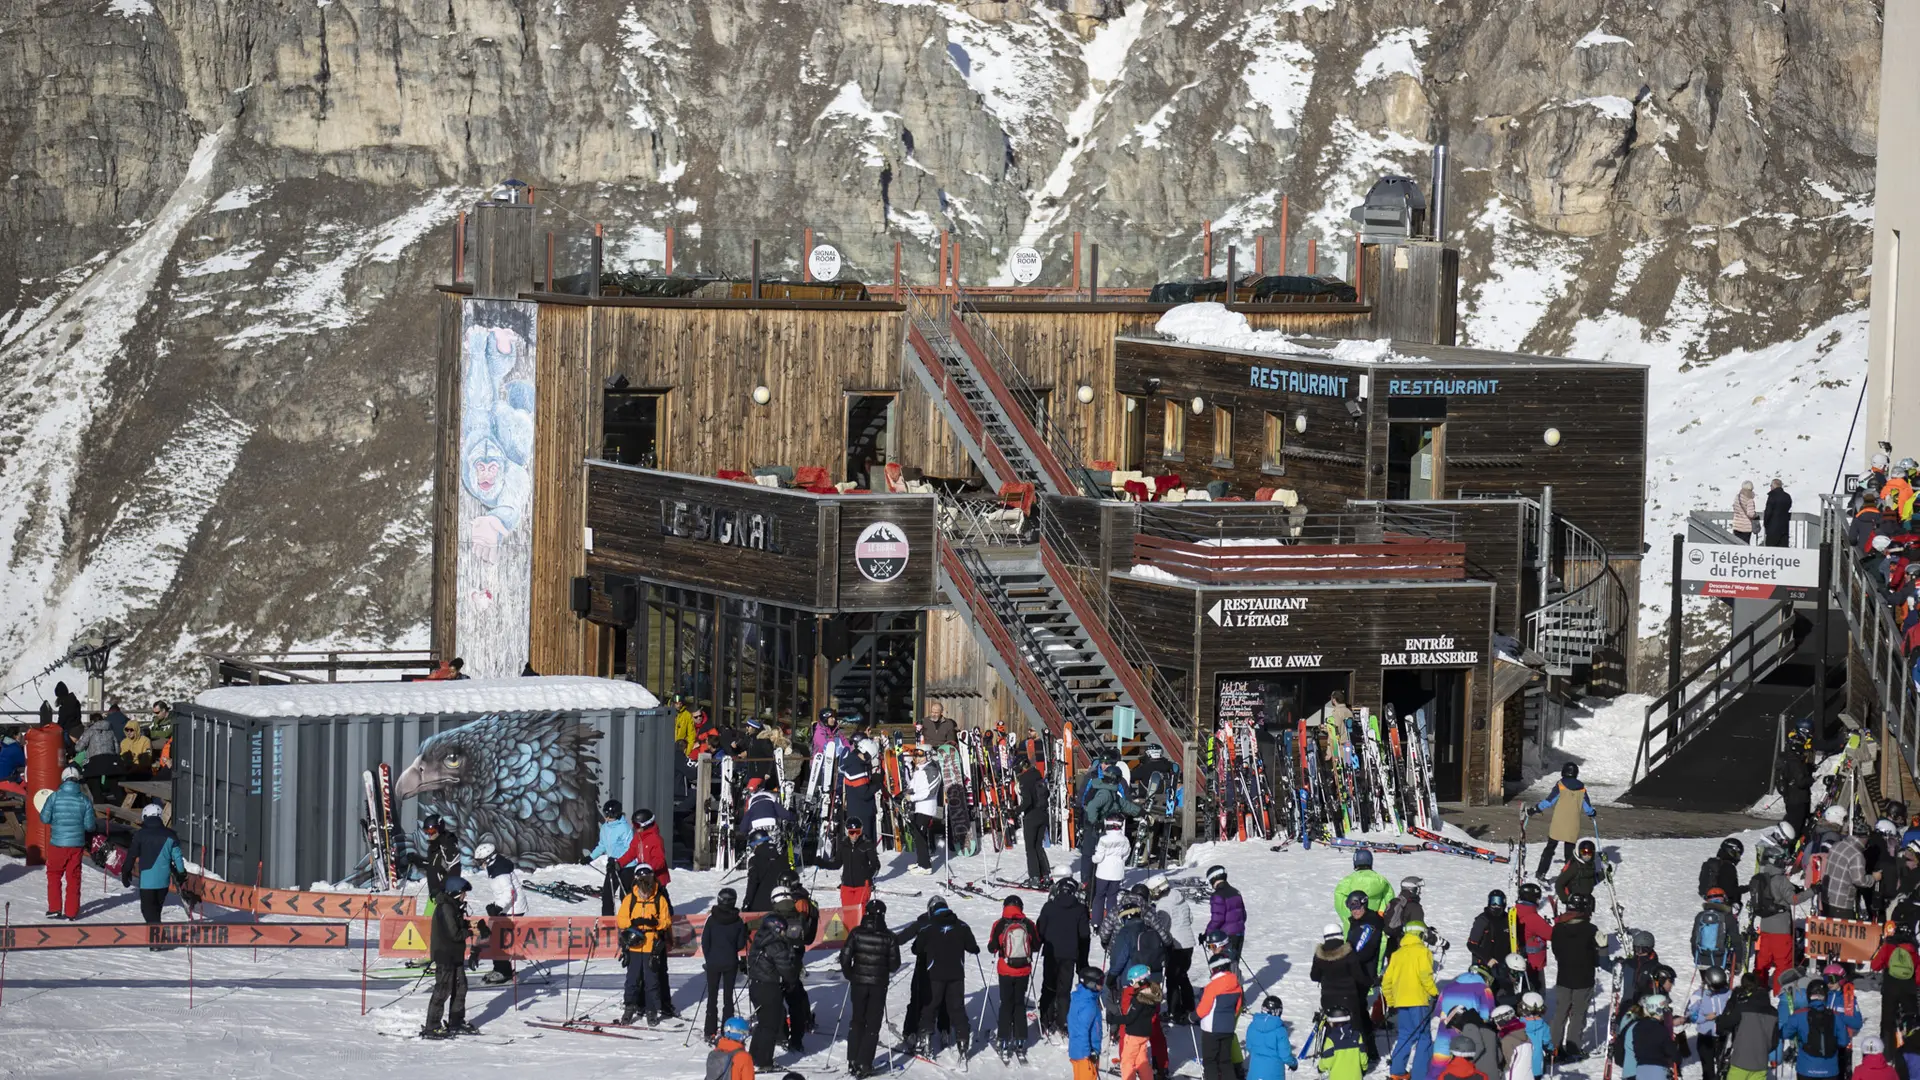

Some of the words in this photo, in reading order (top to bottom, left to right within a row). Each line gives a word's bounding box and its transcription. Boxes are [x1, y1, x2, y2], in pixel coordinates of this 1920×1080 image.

[1250, 366, 1348, 398] RESTAURANT
[1389, 380, 1498, 395] RESTAURANT
[1710, 551, 1801, 570] Téléphérique
[1710, 564, 1727, 577] du
[1731, 566, 1777, 579] Fornet
[1223, 598, 1309, 610] RESTAURANT
[1223, 611, 1233, 627] À
[1236, 611, 1289, 627] L'ÉTAGE
[1404, 634, 1455, 650] ENTRÉE
[1248, 656, 1283, 668] TAKE
[1285, 655, 1323, 668] AWAY
[1380, 653, 1408, 665] BAR
[1410, 651, 1478, 664] BRASSERIE
[252, 731, 262, 776] SIGNAL
[251, 779, 262, 795] LE
[273, 777, 282, 802] VAL
[150, 926, 229, 944] RALENTIR
[500, 927, 622, 949] D'ATTENT
[1809, 921, 1867, 940] RALENTIR
[1809, 940, 1842, 955] SLOW
